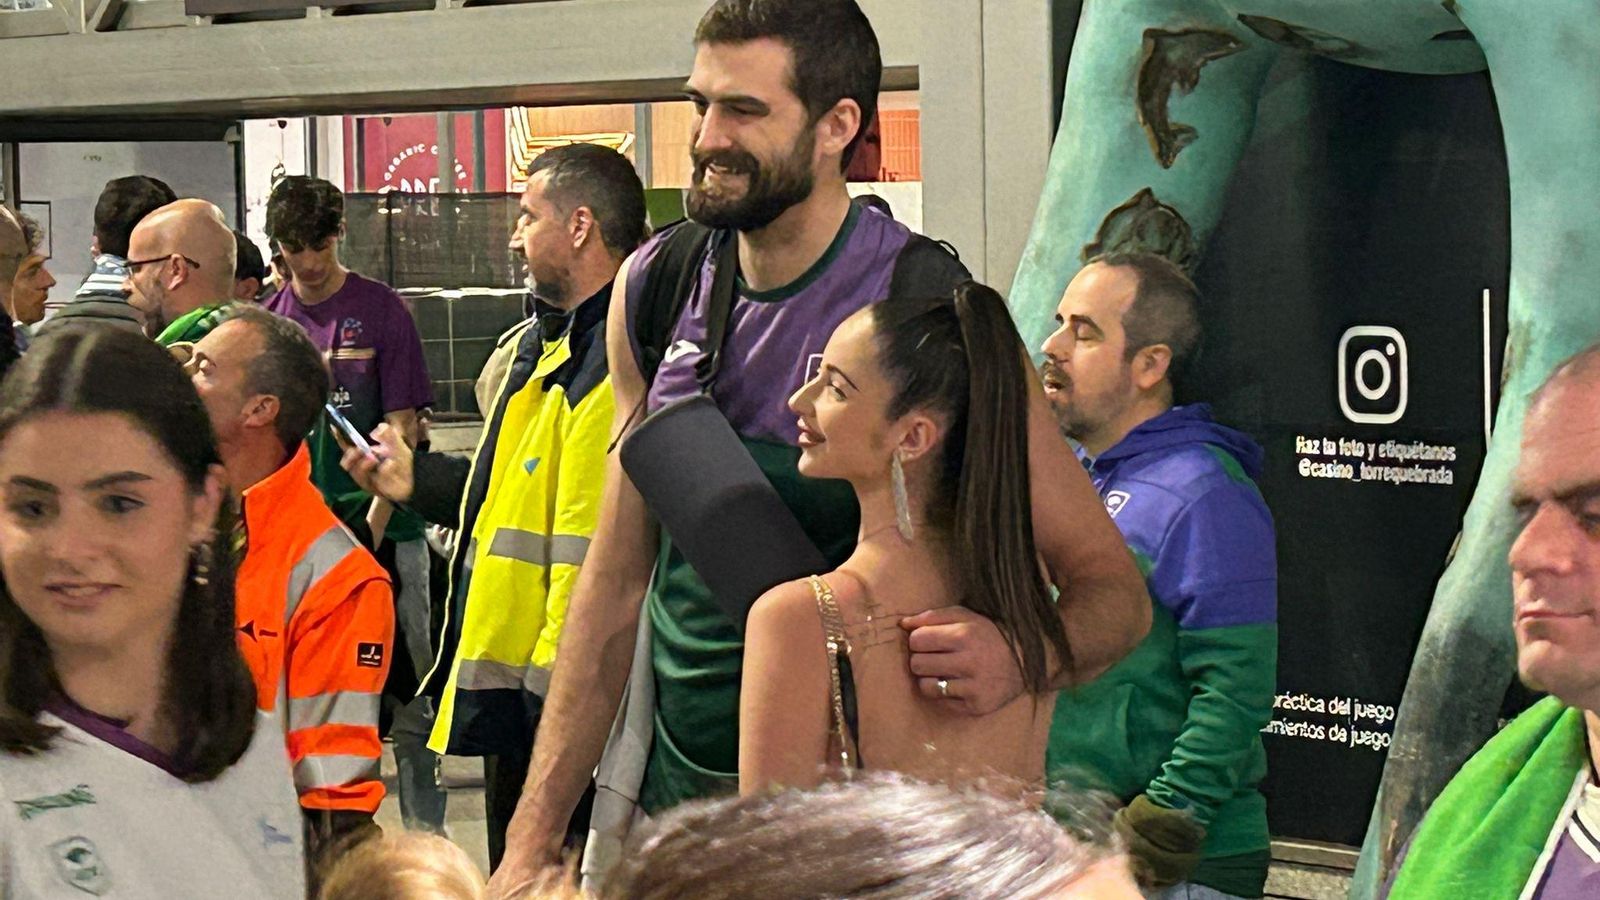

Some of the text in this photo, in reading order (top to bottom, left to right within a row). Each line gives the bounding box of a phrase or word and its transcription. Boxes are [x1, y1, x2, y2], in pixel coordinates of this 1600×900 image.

[1295, 435, 1321, 455] Haz
[1367, 443, 1376, 462] y
[1328, 696, 1351, 716] del
[1353, 698, 1396, 725] juego
[1328, 723, 1348, 743] de
[1349, 725, 1392, 752] juego
